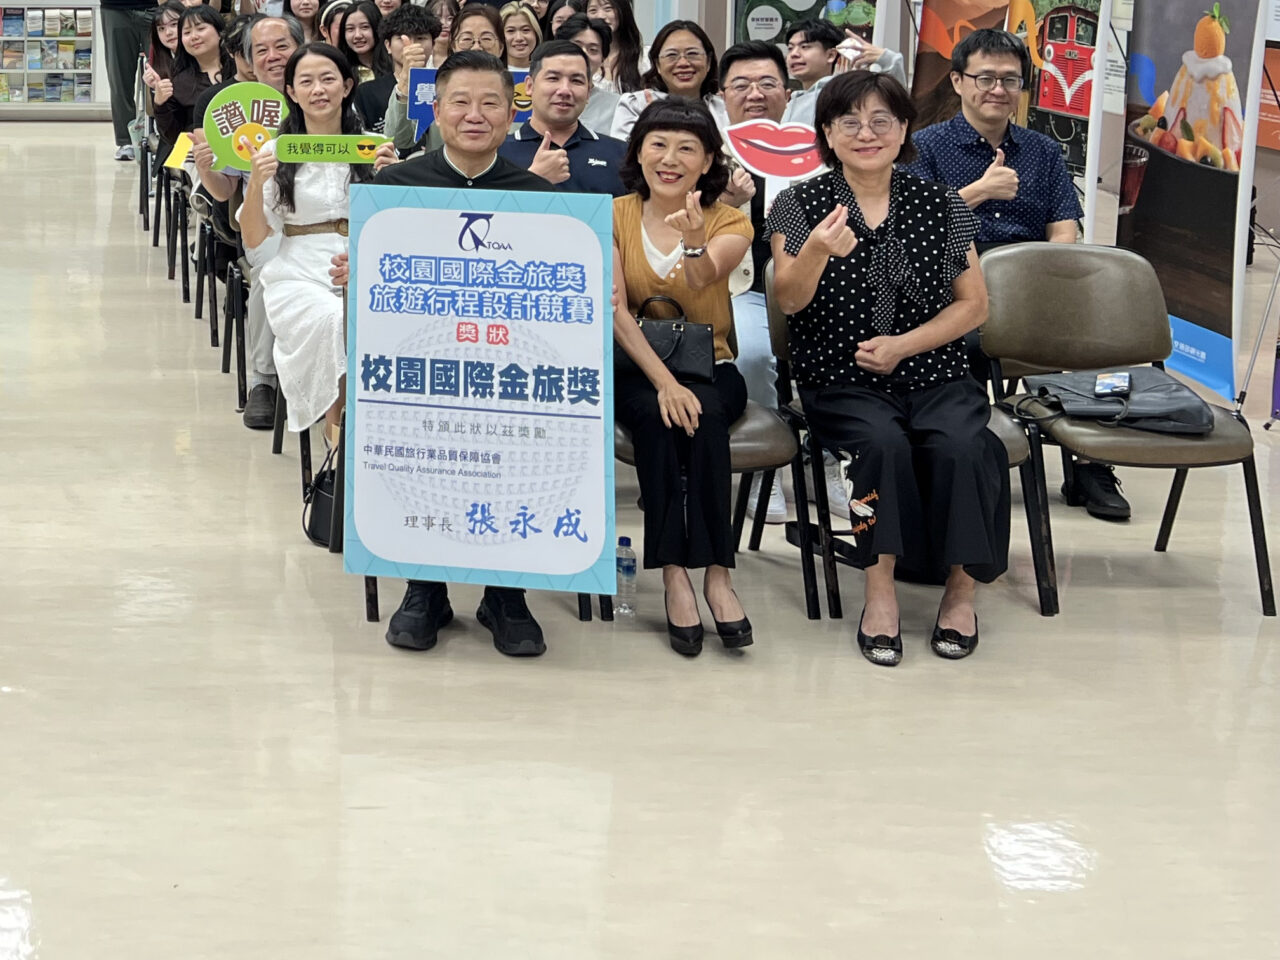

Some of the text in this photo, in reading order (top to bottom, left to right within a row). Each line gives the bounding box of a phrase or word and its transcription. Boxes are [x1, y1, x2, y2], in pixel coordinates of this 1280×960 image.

[212, 98, 282, 136] 讚喔
[286, 143, 350, 156] 我覺得可以
[380, 254, 586, 293] 校園國際金旅獎
[370, 284, 593, 324] 旅遊行程設計競賽
[457, 322, 509, 345] 獎狀
[361, 353, 601, 406] 校園國際金旅獎
[421, 419, 547, 440] 特頒此狀以茲獎勵
[363, 444, 502, 465] 中華民國旅行業品質保障協會
[363, 462, 501, 479] Travel Quality Assurance Association
[404, 503, 588, 543] 理事長 張永成
